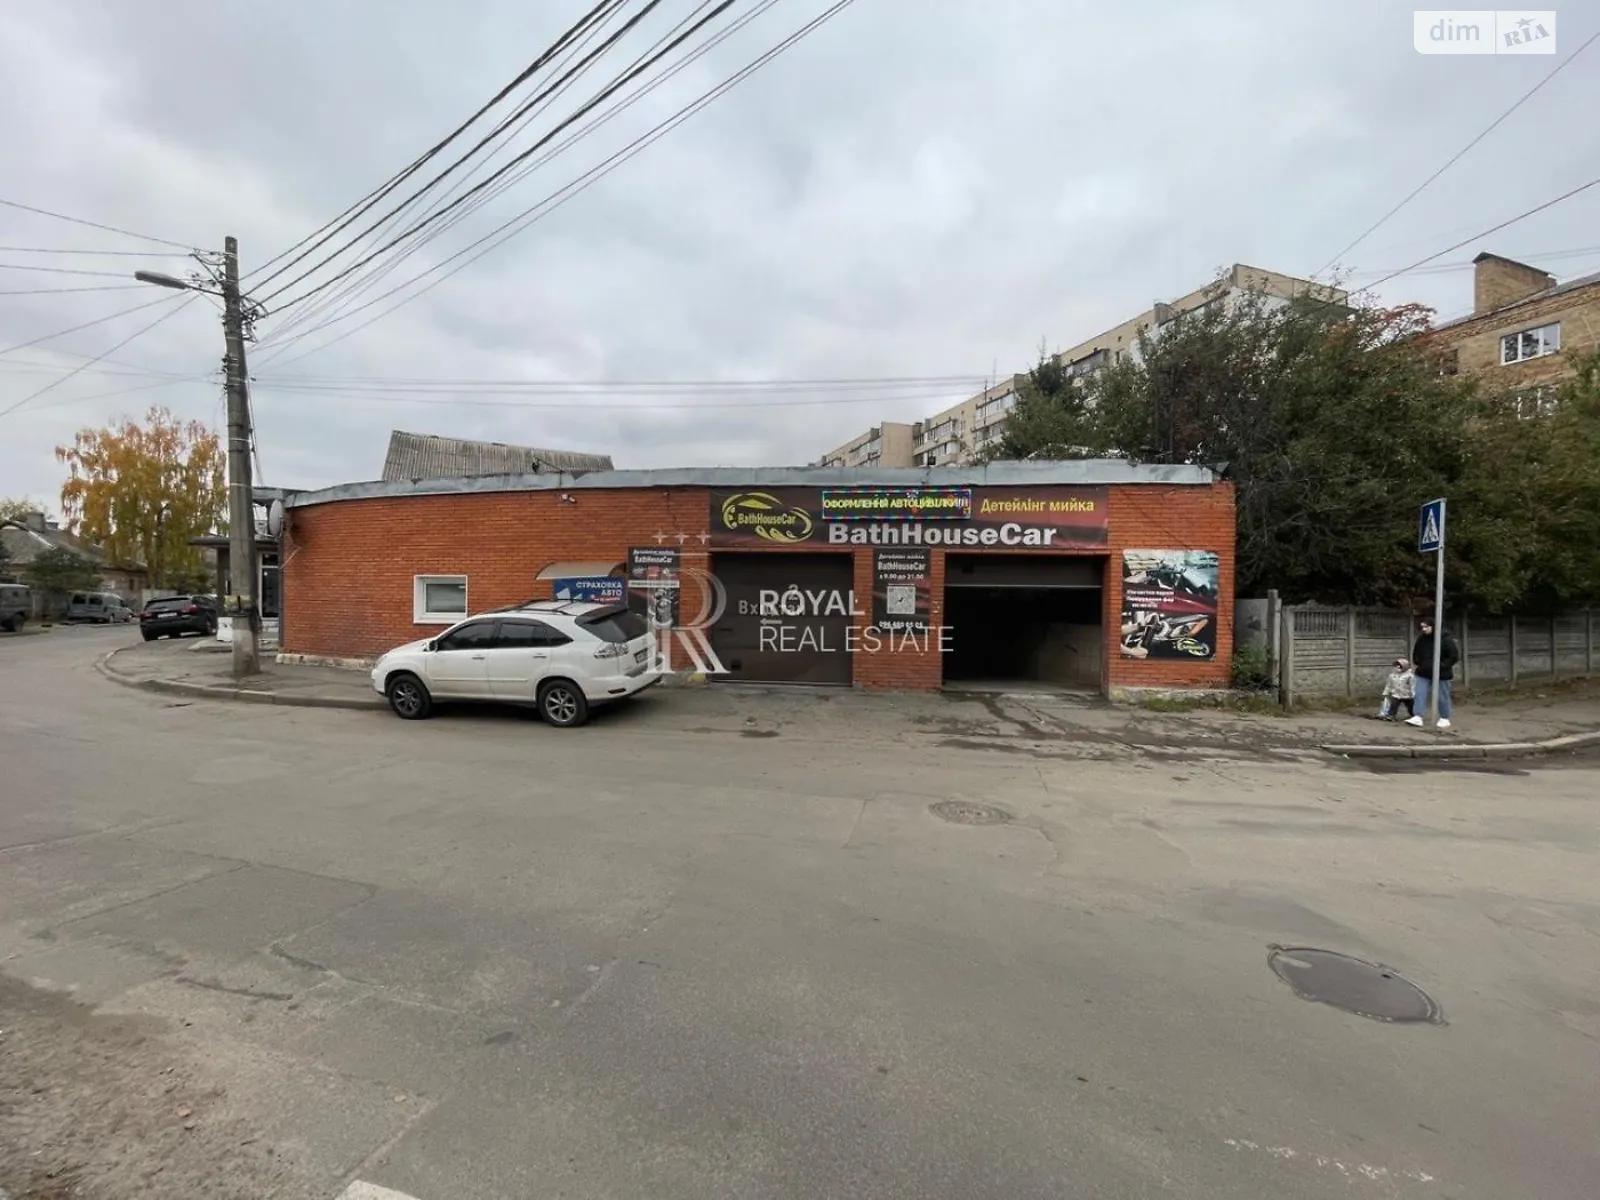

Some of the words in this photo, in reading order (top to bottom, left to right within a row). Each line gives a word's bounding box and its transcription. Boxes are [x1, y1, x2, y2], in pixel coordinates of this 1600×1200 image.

[980, 498, 1046, 514] Детейлінг
[1050, 498, 1095, 512] мийка
[737, 513, 796, 525] BathHouseCar
[829, 522, 1057, 545] BathHouseCar
